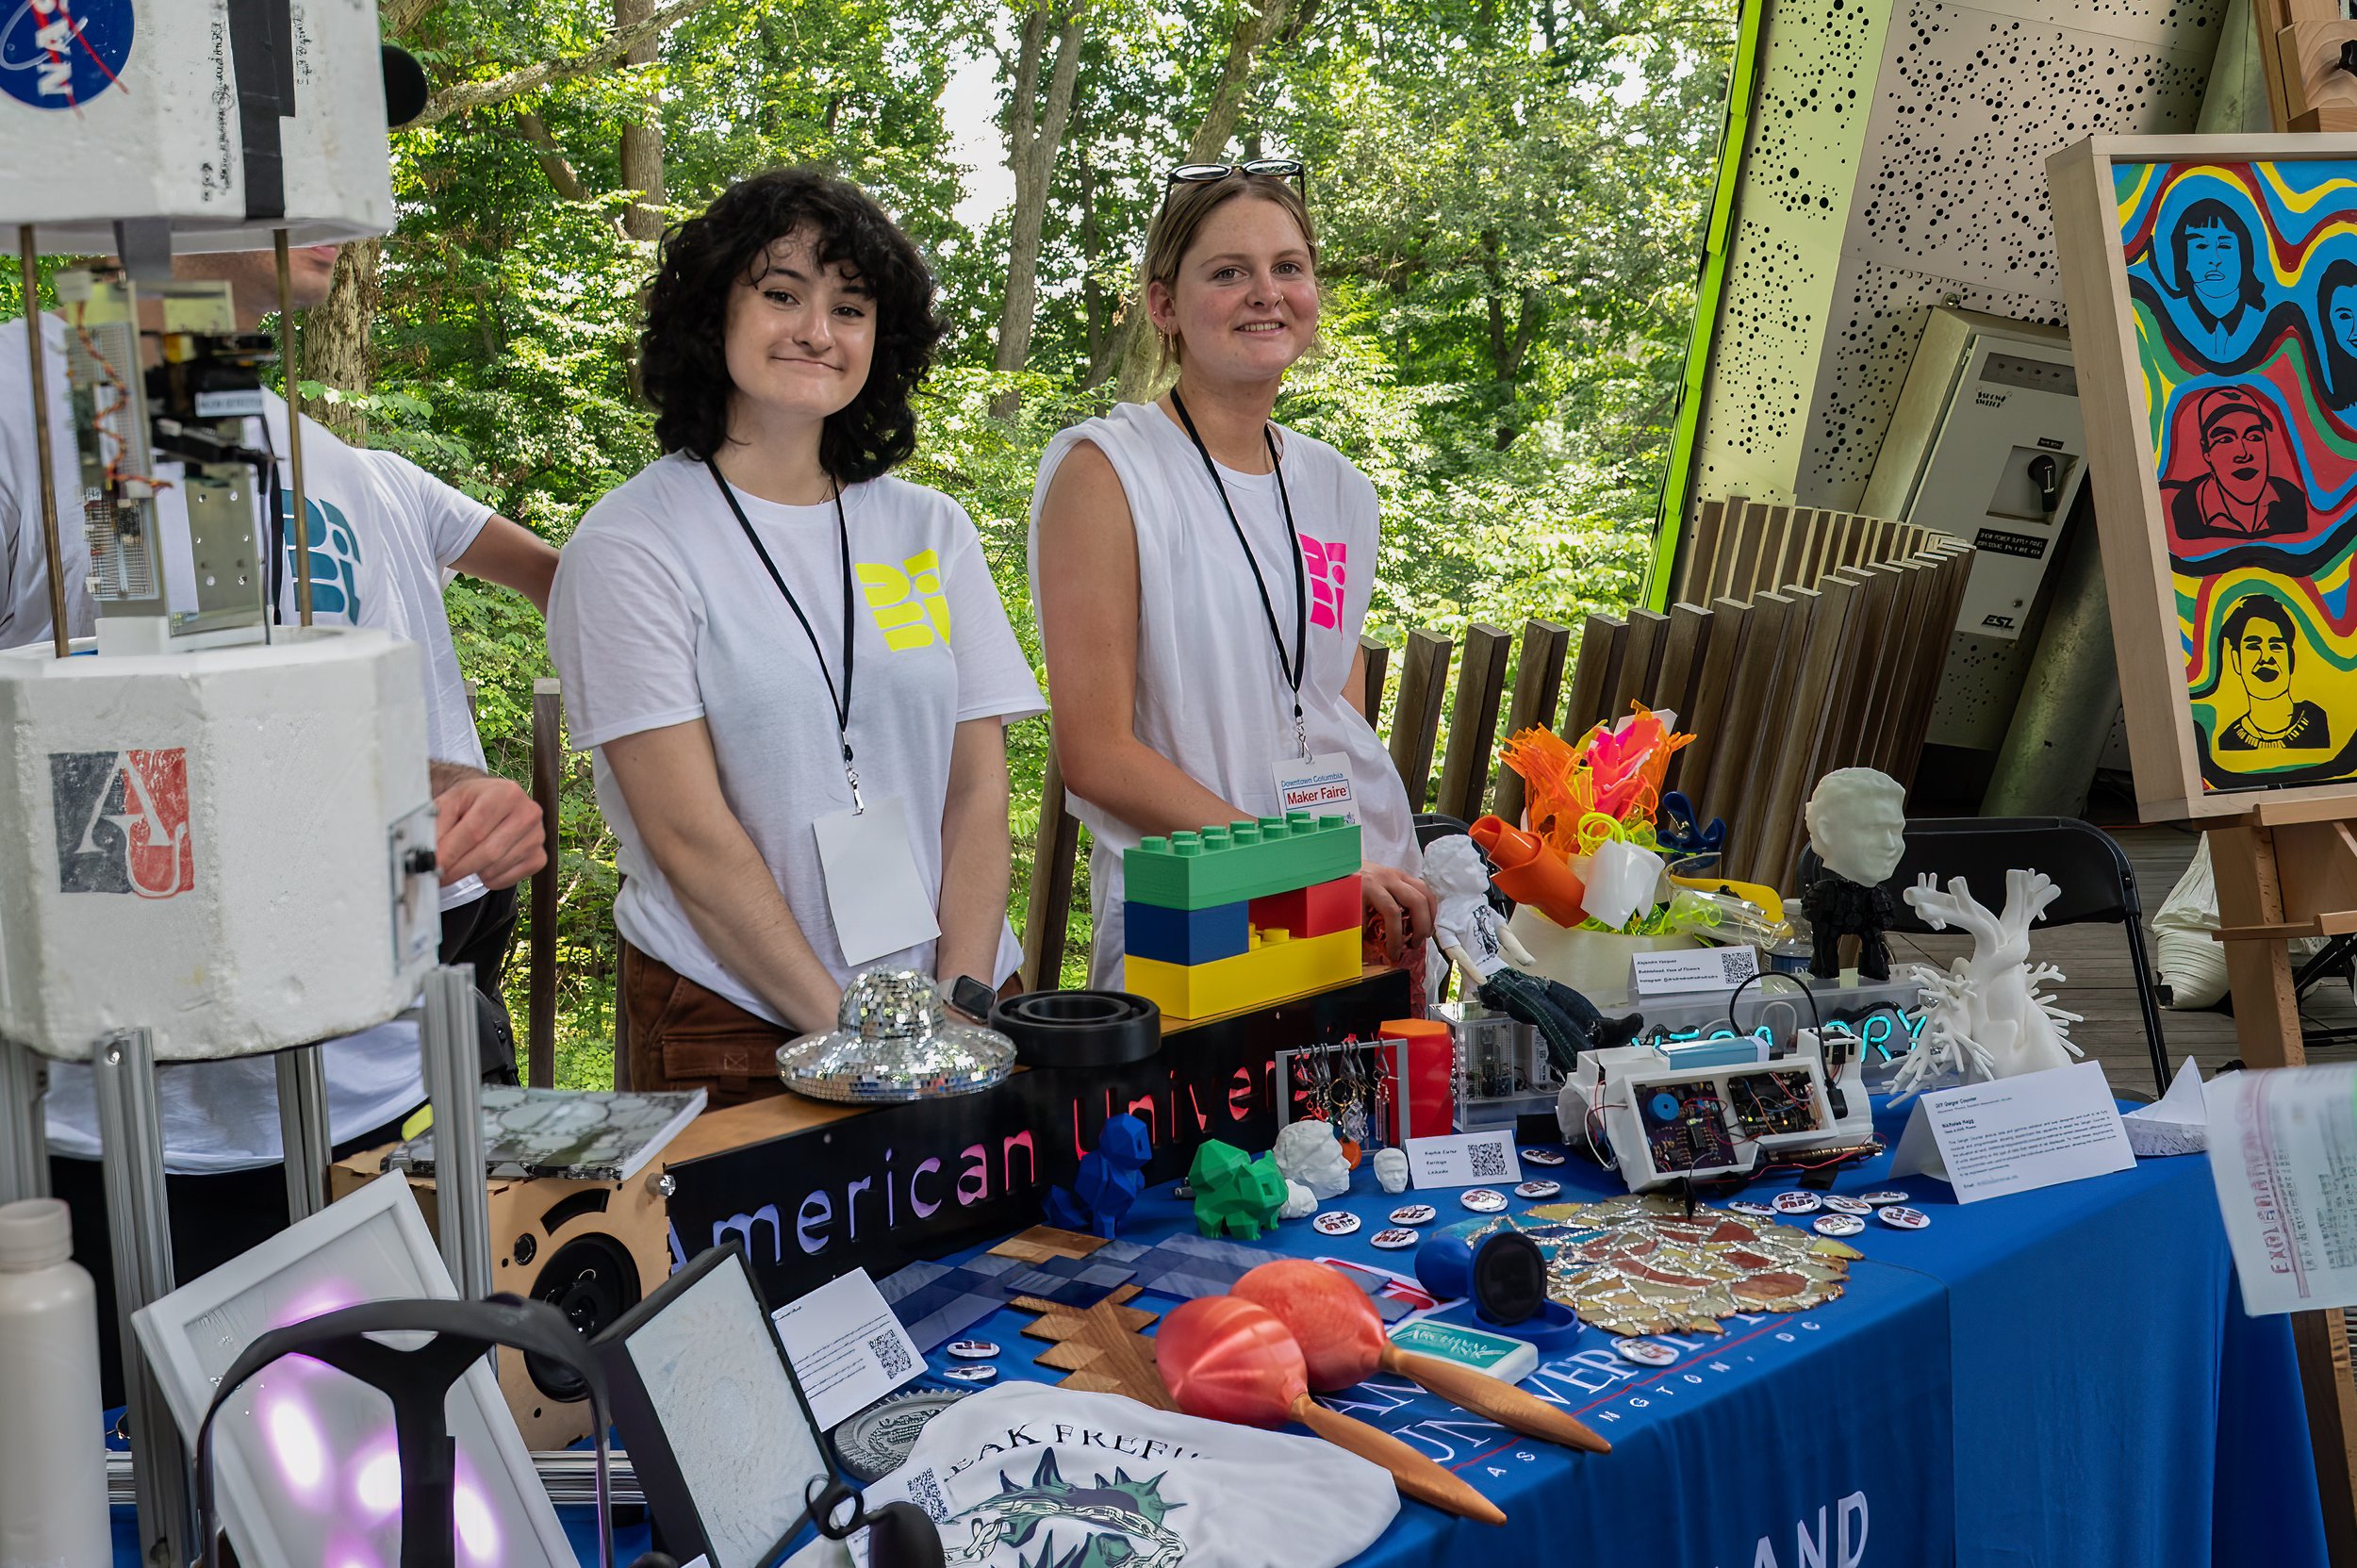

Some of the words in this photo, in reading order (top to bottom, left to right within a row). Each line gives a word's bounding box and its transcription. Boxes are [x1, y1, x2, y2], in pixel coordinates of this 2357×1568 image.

[1281, 778, 1313, 787] Downtown
[1313, 772, 1343, 783] Columbia
[1287, 791, 1318, 805] Maker
[1320, 786, 1346, 800] Faire
